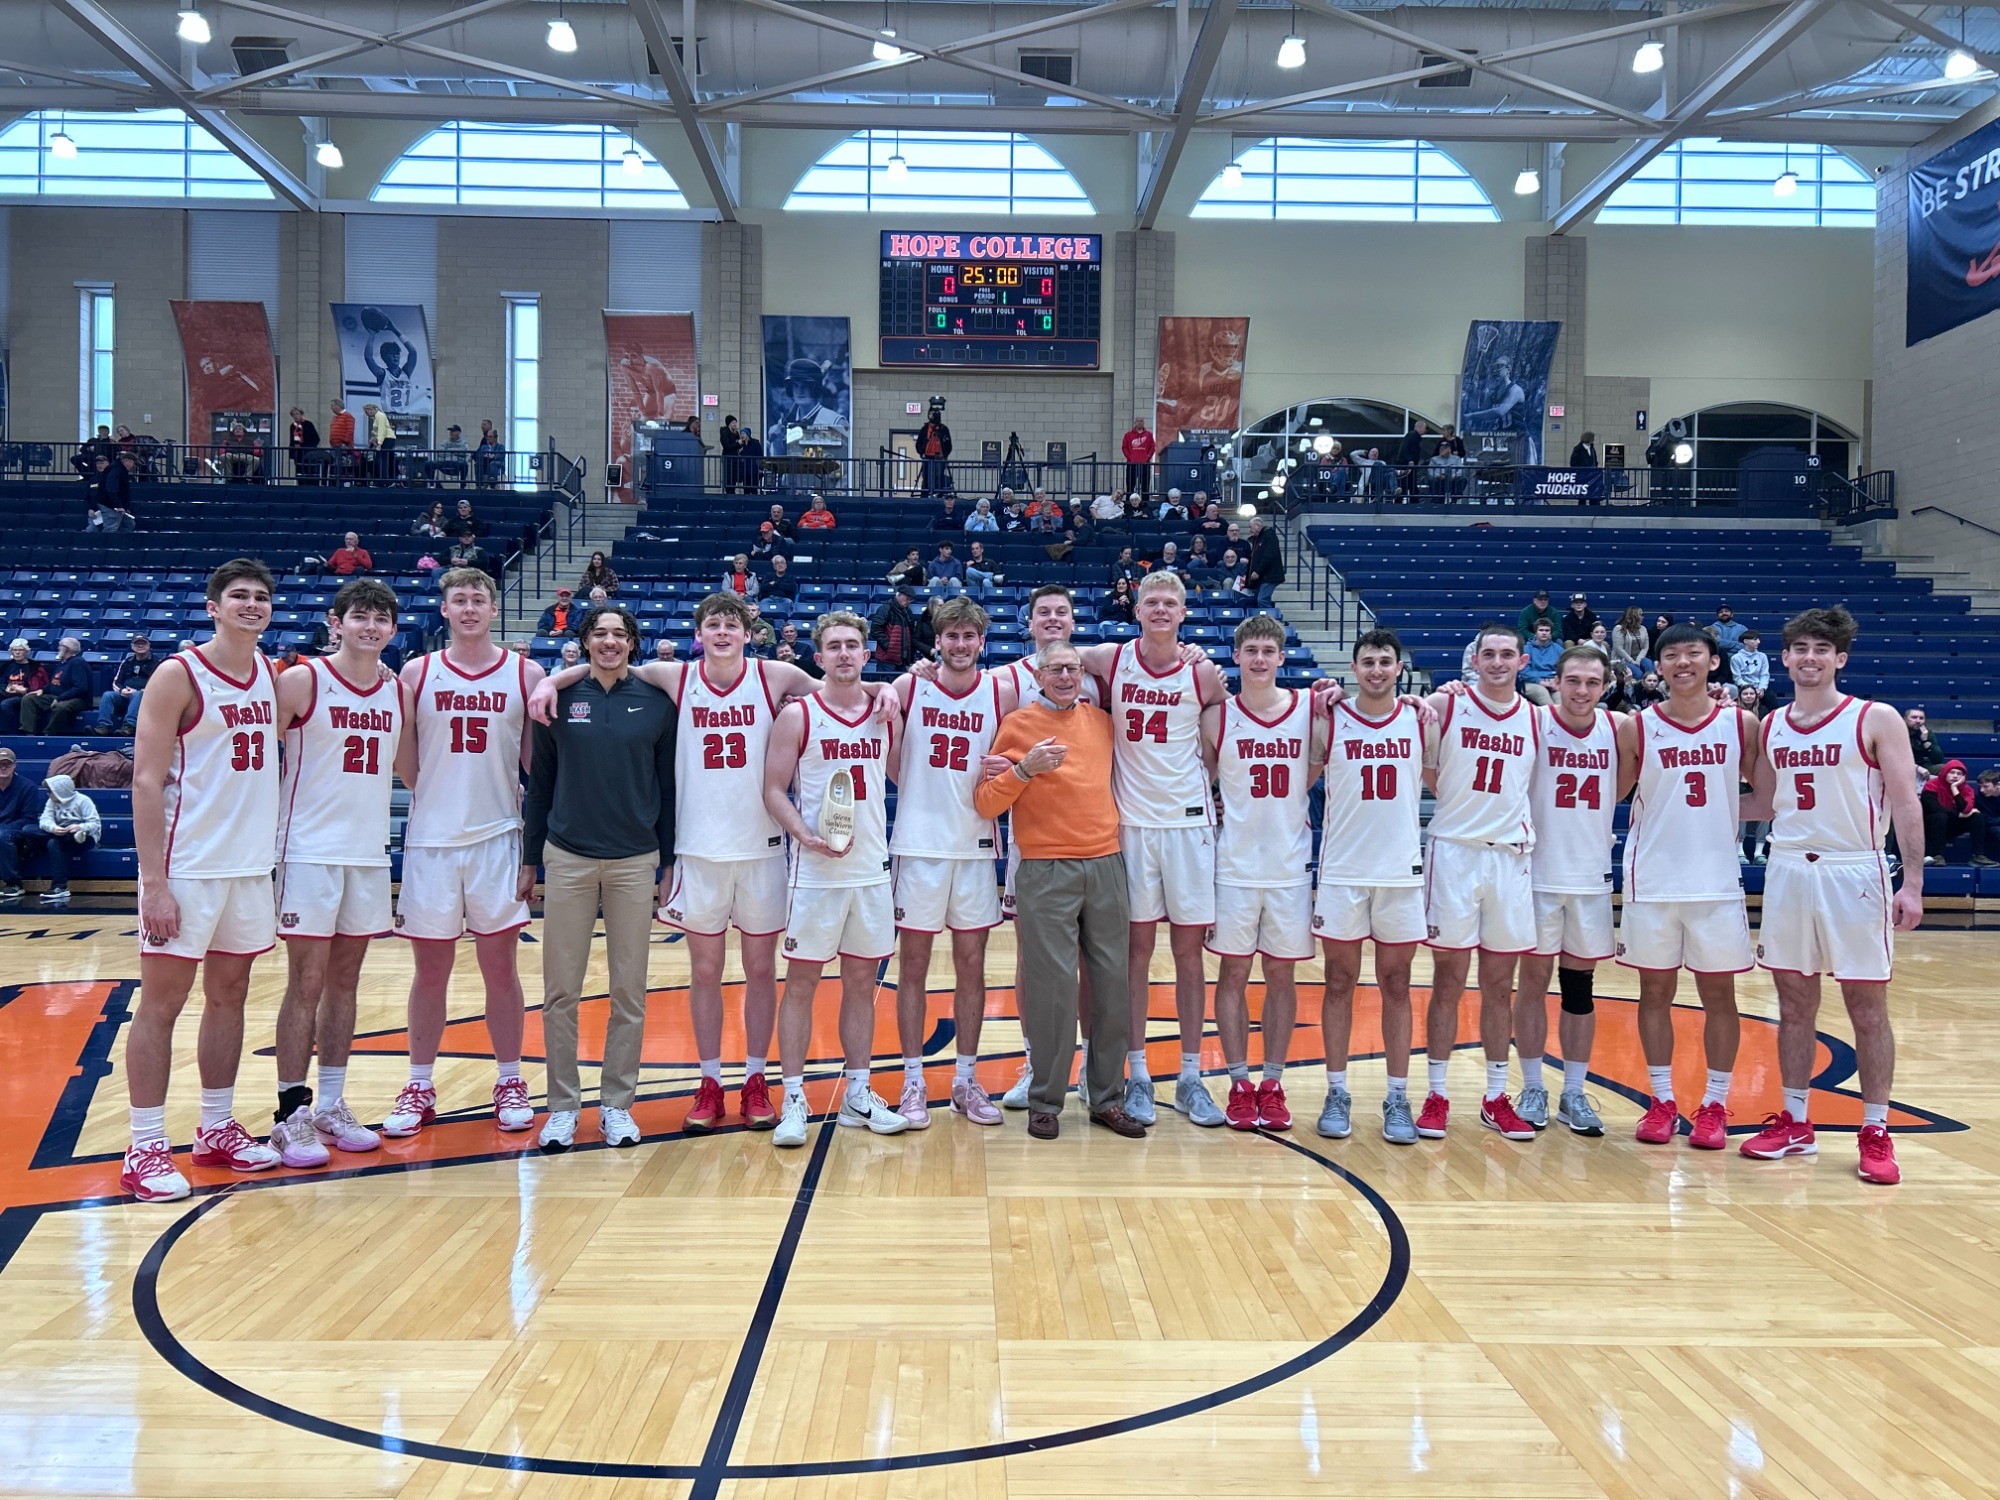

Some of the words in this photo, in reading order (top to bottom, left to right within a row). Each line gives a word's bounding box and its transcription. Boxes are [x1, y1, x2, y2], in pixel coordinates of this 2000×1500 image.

[1922, 177, 1948, 219] BE
[890, 235, 960, 257] HOPE
[969, 236, 1090, 259] COLLEGE
[930, 265, 954, 274] HOME
[963, 267, 1018, 284] 25:00
[1023, 266, 1055, 276] VISITOR
[944, 276, 955, 294] 0
[1041, 278, 1052, 296] 0
[1002, 291, 1007, 305] 1
[937, 314, 946, 328] 0
[956, 318, 963, 328] 4
[1018, 320, 1025, 329] 4
[1043, 315, 1052, 330] 0
[391, 389, 410, 406] 21
[1200, 395, 1231, 421] 20
[532, 457, 540, 467] 8
[664, 460, 672, 470] 9
[1207, 451, 1215, 460] 9
[1306, 452, 1318, 461] 10
[1807, 457, 1819, 466] 10
[1190, 468, 1198, 478] 9
[1319, 470, 1331, 480] 10
[1547, 472, 1577, 483] HOPE
[1794, 475, 1806, 484] 10
[1534, 484, 1589, 495] STUDENTS
[434, 690, 507, 713] WashU
[1121, 683, 1182, 706] WashU
[328, 706, 393, 733] WashU
[691, 704, 755, 728] WashU
[922, 706, 984, 733] WashU
[1125, 709, 1168, 743] 34
[450, 716, 489, 753] 15
[1460, 726, 1525, 757] WashU
[231, 731, 264, 772] 33
[342, 735, 380, 775] 21
[703, 732, 747, 769] 23
[820, 738, 882, 760] WashU
[929, 733, 970, 771] 32
[1236, 738, 1302, 759] WashU
[1344, 738, 1411, 760] WashU
[1547, 746, 1609, 769] WashU
[1658, 743, 1728, 769] WashU
[1773, 743, 1842, 769] WashU
[1250, 764, 1289, 798] 30
[1361, 764, 1397, 800] 10
[1472, 755, 1505, 794] 11
[1555, 773, 1601, 810] 24
[1684, 771, 1707, 807] 3
[1794, 772, 1816, 811] 5
[833, 813, 851, 822] Glenn
[829, 827, 850, 836] Classic
